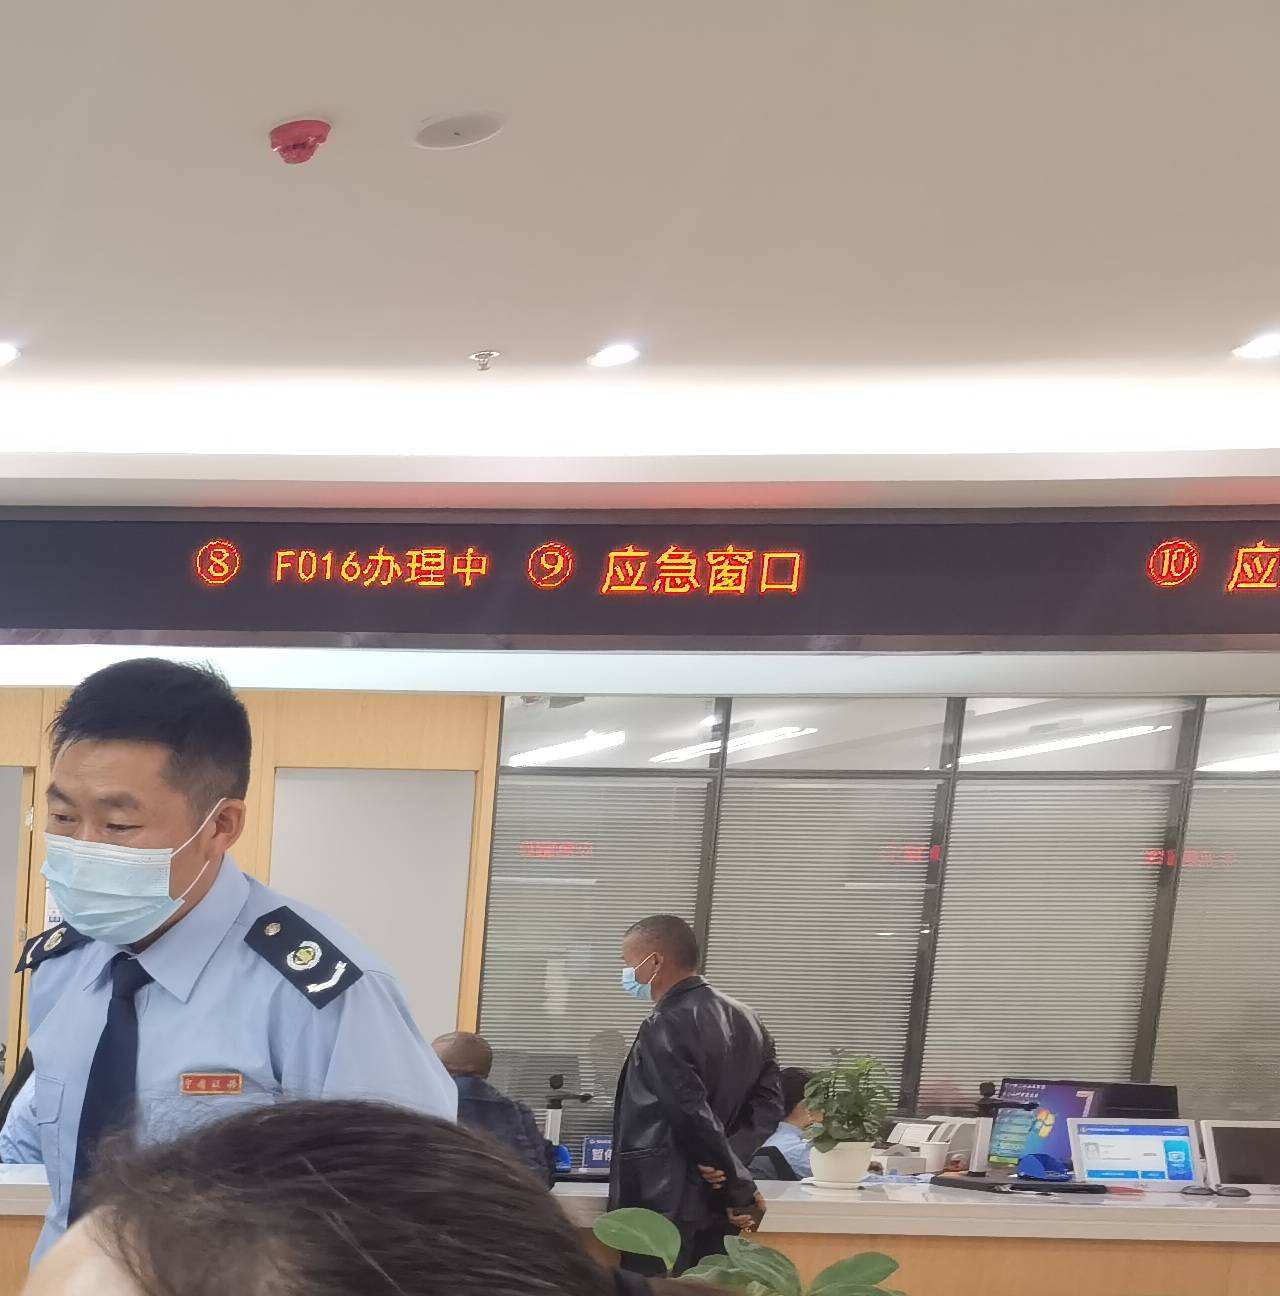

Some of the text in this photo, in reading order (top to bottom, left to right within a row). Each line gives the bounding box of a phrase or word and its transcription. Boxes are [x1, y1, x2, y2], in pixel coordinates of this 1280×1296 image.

[274, 547, 489, 587] F016办理中
[599, 545, 804, 596] 应急窗口
